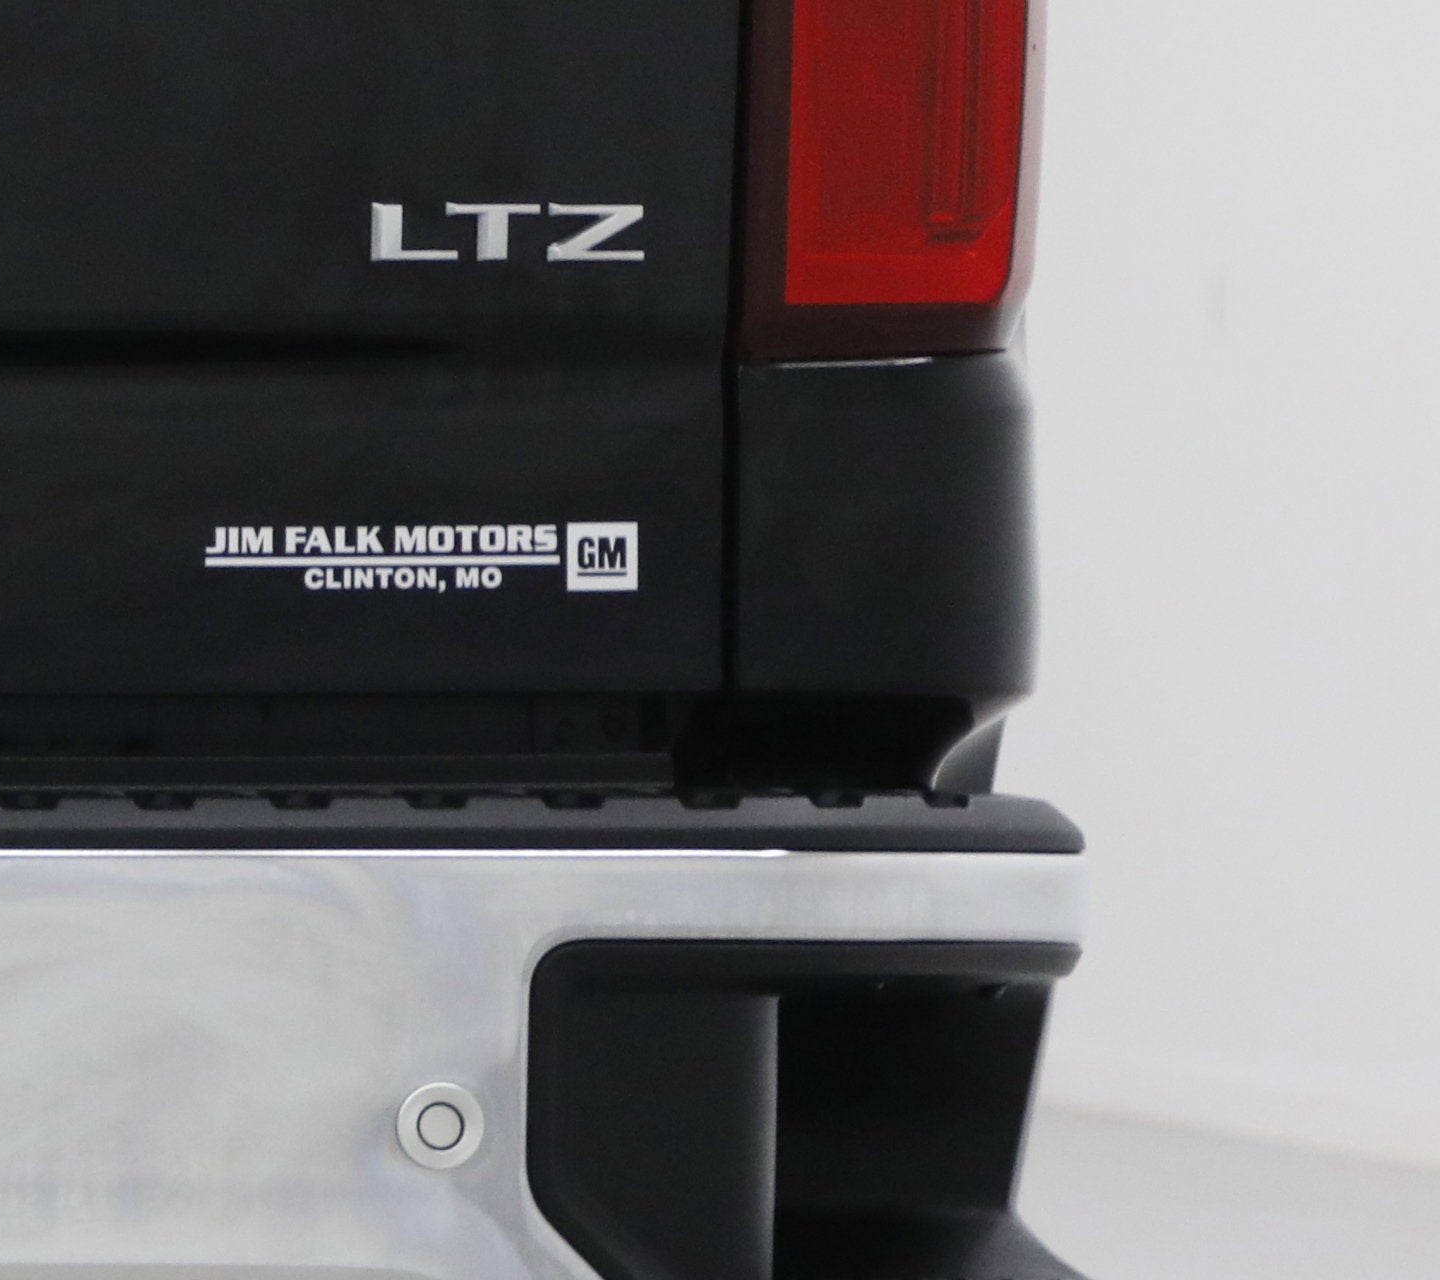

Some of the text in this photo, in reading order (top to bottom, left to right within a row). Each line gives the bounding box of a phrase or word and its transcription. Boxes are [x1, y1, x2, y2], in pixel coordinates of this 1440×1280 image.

[370, 202, 646, 262] LTZ
[205, 524, 558, 555] JIM FALK MOTORS
[577, 536, 628, 570] GM
[303, 566, 503, 593] CLINTON, MO
